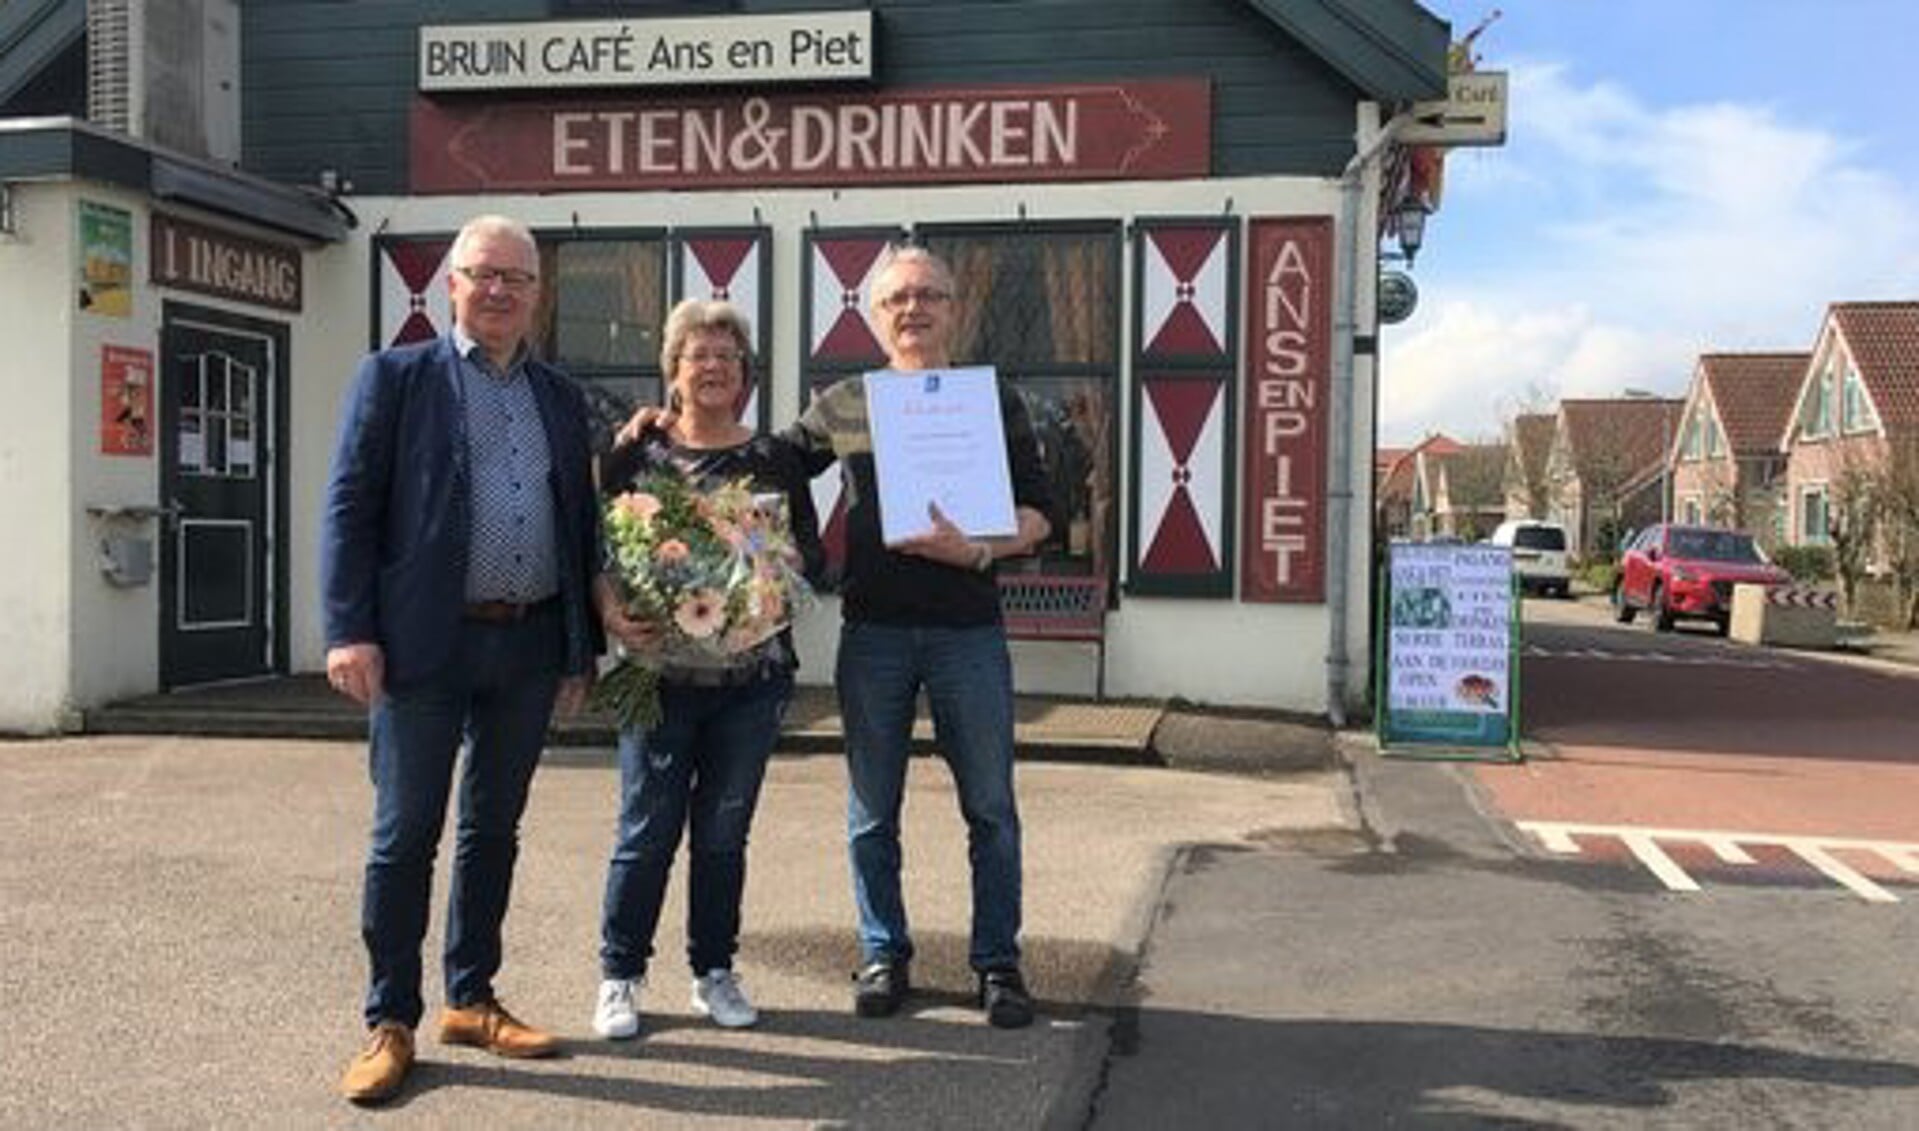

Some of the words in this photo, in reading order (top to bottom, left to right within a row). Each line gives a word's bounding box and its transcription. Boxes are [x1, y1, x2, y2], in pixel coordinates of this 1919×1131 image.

[426, 40, 526, 77] BRUIN
[541, 26, 635, 73] CAFÉ
[648, 37, 714, 72] Ans
[727, 38, 773, 68] en
[789, 30, 864, 67] Piet
[552, 97, 1078, 175] ETEN&DRINKEN
[188, 236, 297, 303] INGANG
[1258, 379, 1316, 410] EN
